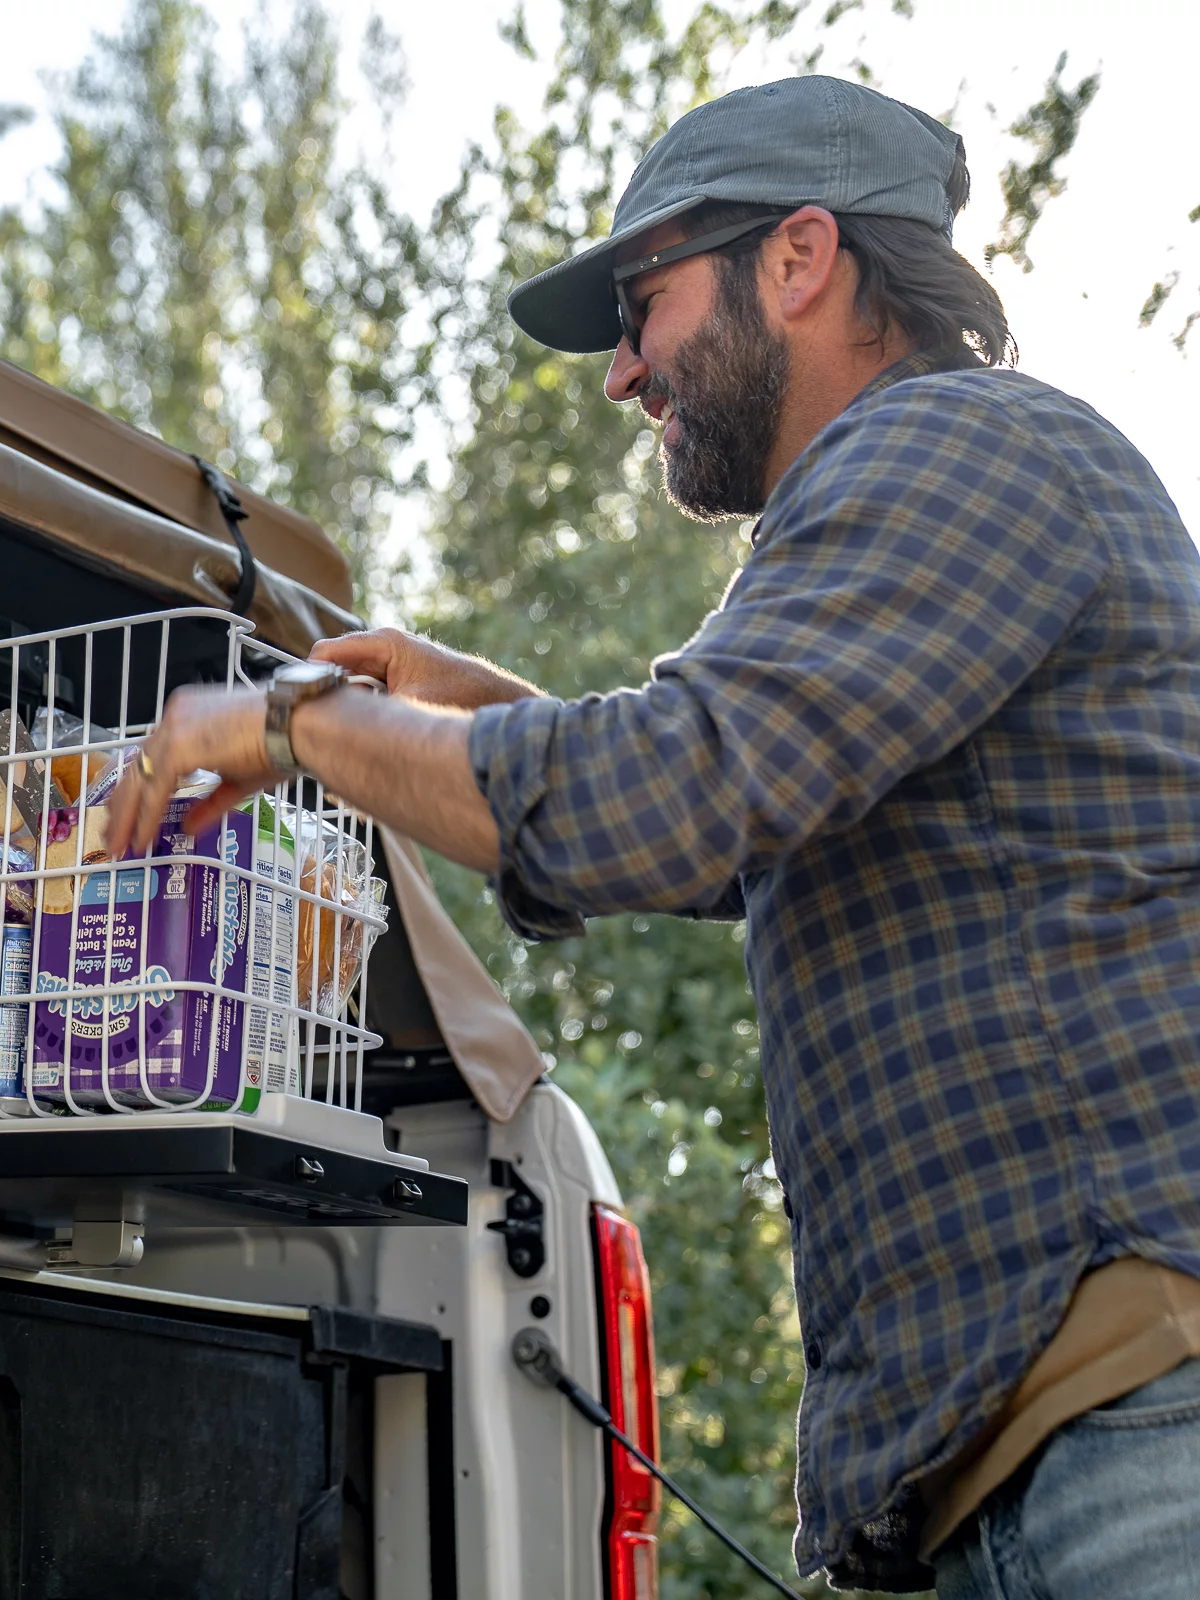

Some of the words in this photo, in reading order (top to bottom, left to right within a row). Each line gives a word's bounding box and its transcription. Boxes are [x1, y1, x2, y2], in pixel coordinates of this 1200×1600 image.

[279, 872, 292, 880] acts
[171, 885, 181, 893] 210
[75, 927, 94, 939] Jell
[95, 926, 126, 937] Grpe
[128, 925, 136, 935] &
[69, 939, 100, 951] Butte
[103, 938, 137, 949] Peant
[71, 1019, 126, 1037] SMCKER'S
